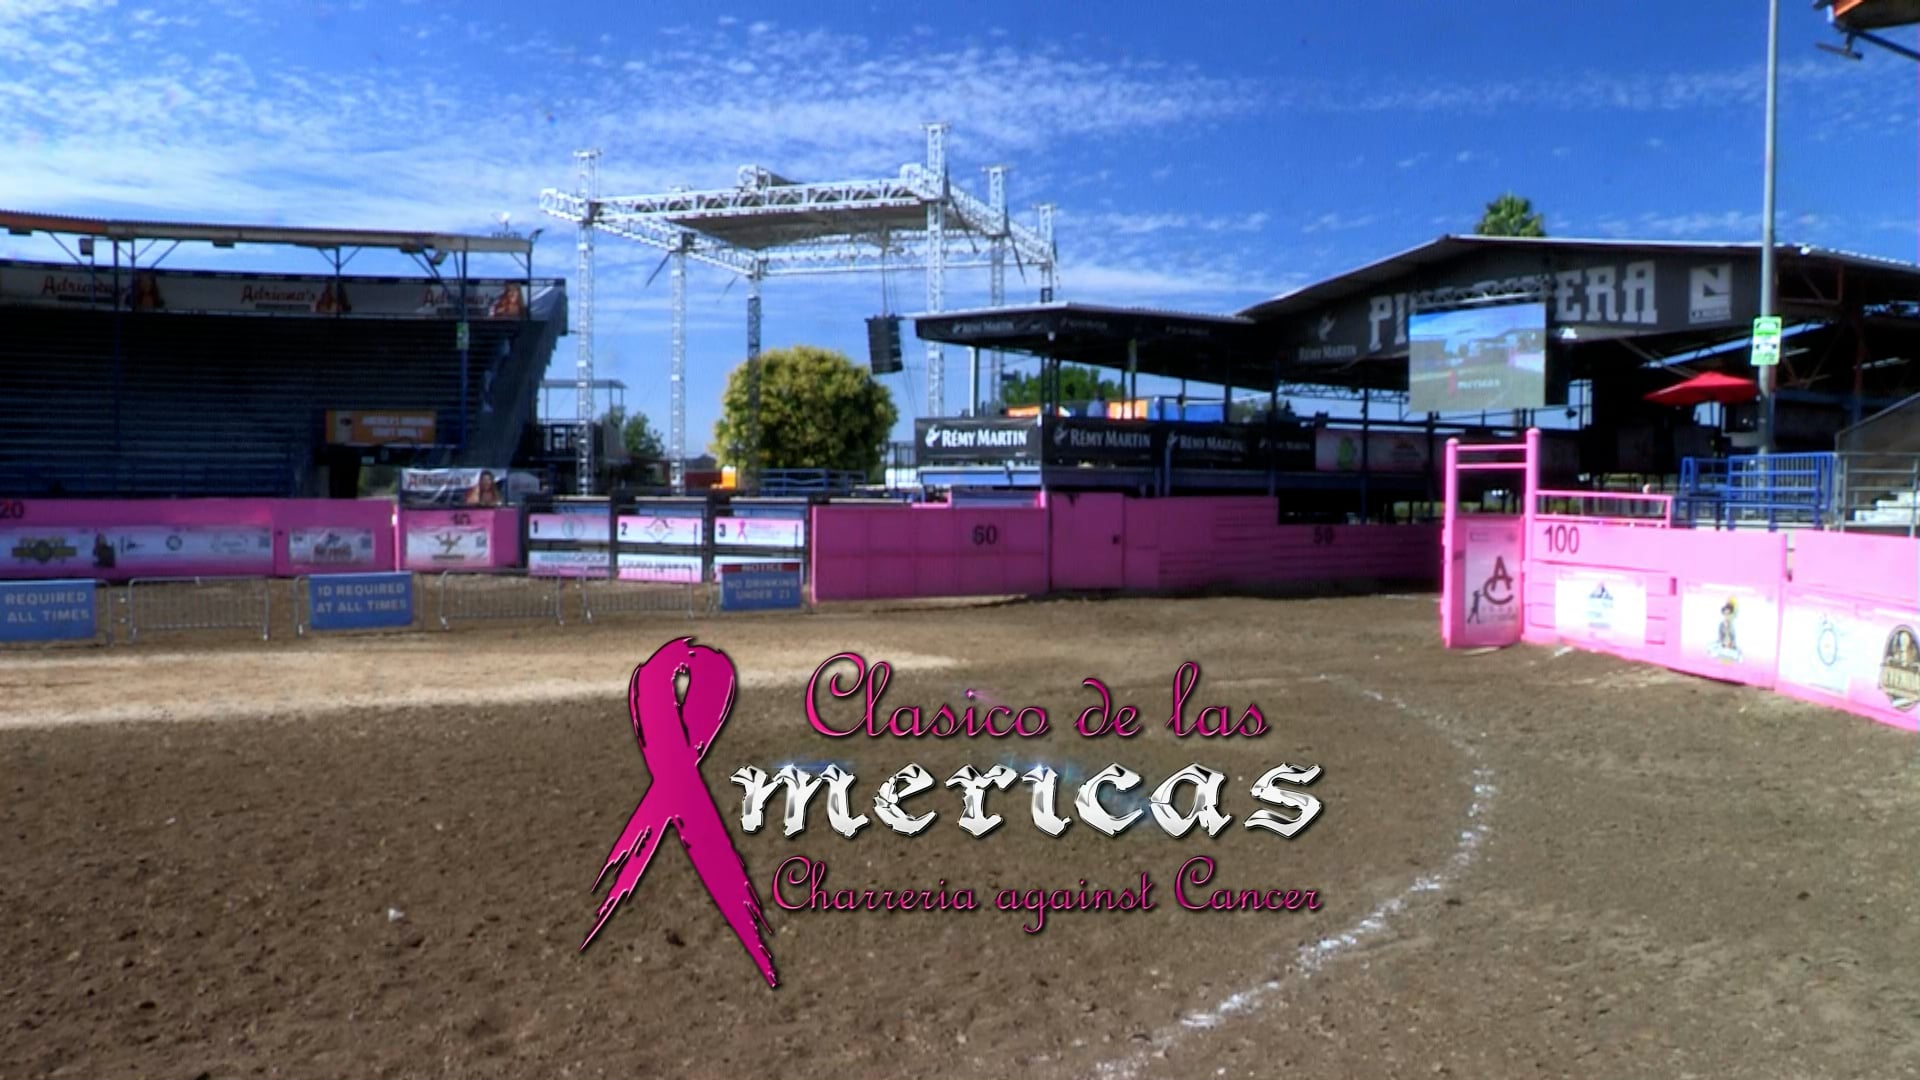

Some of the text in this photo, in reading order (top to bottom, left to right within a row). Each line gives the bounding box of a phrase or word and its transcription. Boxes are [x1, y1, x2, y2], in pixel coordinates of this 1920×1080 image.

[977, 427, 1028, 448] MARTIN
[1104, 430, 1150, 448] MARTIN
[972, 524, 998, 546] 60
[1544, 524, 1581, 554] 100
[336, 582, 406, 597] REQUIRED
[5, 591, 88, 606] REQUIRED
[316, 598, 407, 613] AT ALL TIMES
[7, 608, 90, 625] ALL TIMES
